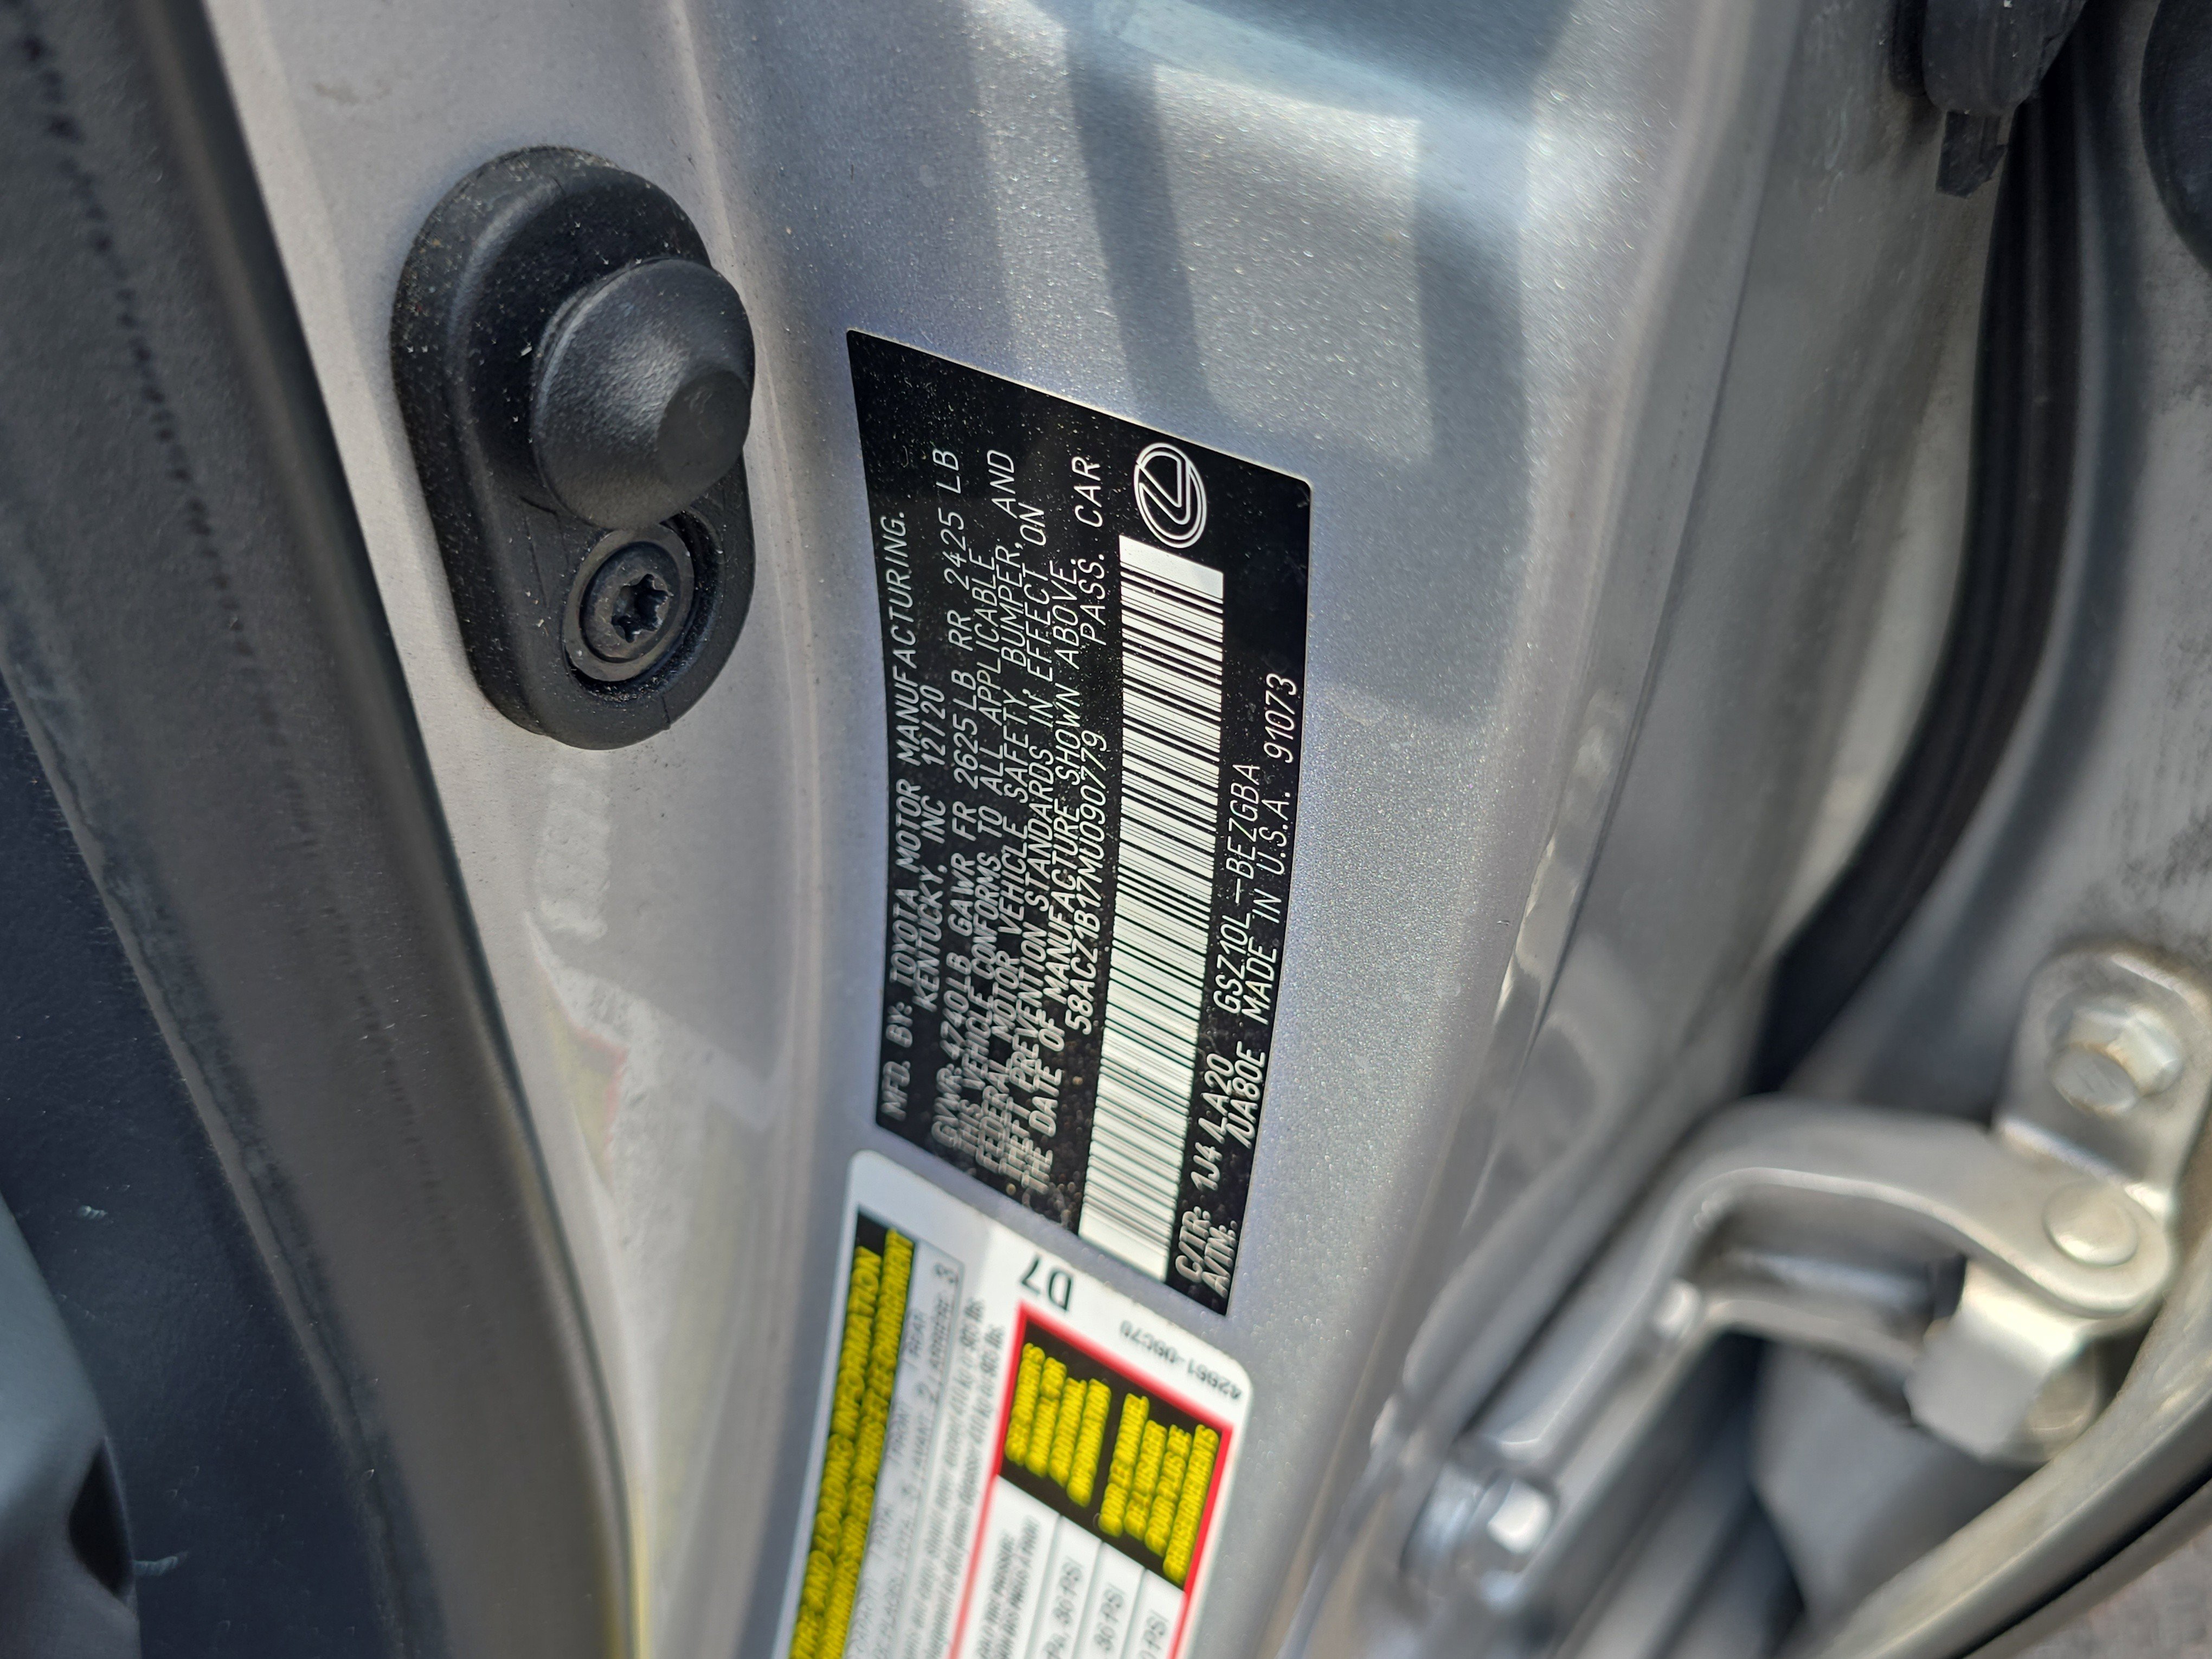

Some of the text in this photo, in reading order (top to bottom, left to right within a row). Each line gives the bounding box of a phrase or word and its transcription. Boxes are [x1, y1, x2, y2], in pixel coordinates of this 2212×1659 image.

[932, 448, 962, 494] LB
[937, 507, 970, 590] 2425
[947, 609, 973, 652] RR
[1064, 455, 1107, 1036] 58ACZ1B17MU090779 PASS. CAR
[1263, 672, 1297, 764] 91073
[880, 511, 921, 1121] MFD. BY: TOYOTA MOTOR MANUFACTURING.
[912, 685, 948, 1012] KENTUCKY, INC 12/20
[951, 801, 976, 841] FR
[955, 548, 1004, 1158] THIS VEHICLE CONFORMS TO ALL APPLICABLE
[975, 448, 1032, 1174] FEDERAL MOTOR VEHICLE SAFETY, BUMPER, AND
[998, 502, 1054, 1180] THEFT PREVENTION STANDARDS IN EFFECT ON
[1255, 791, 1291, 876] U.S.A.
[948, 853, 976, 936] GAWR
[1020, 558, 1081, 1194] THE DATE OF MANUFACTURE SHOWN ABOVE.
[1252, 888, 1283, 924] IN
[1242, 936, 1278, 1025] MADE
[1018, 1252, 1074, 1311] D7
[1175, 1205, 1212, 1283] C/TR:
[828, 1245, 883, 1440] INFORMATION
